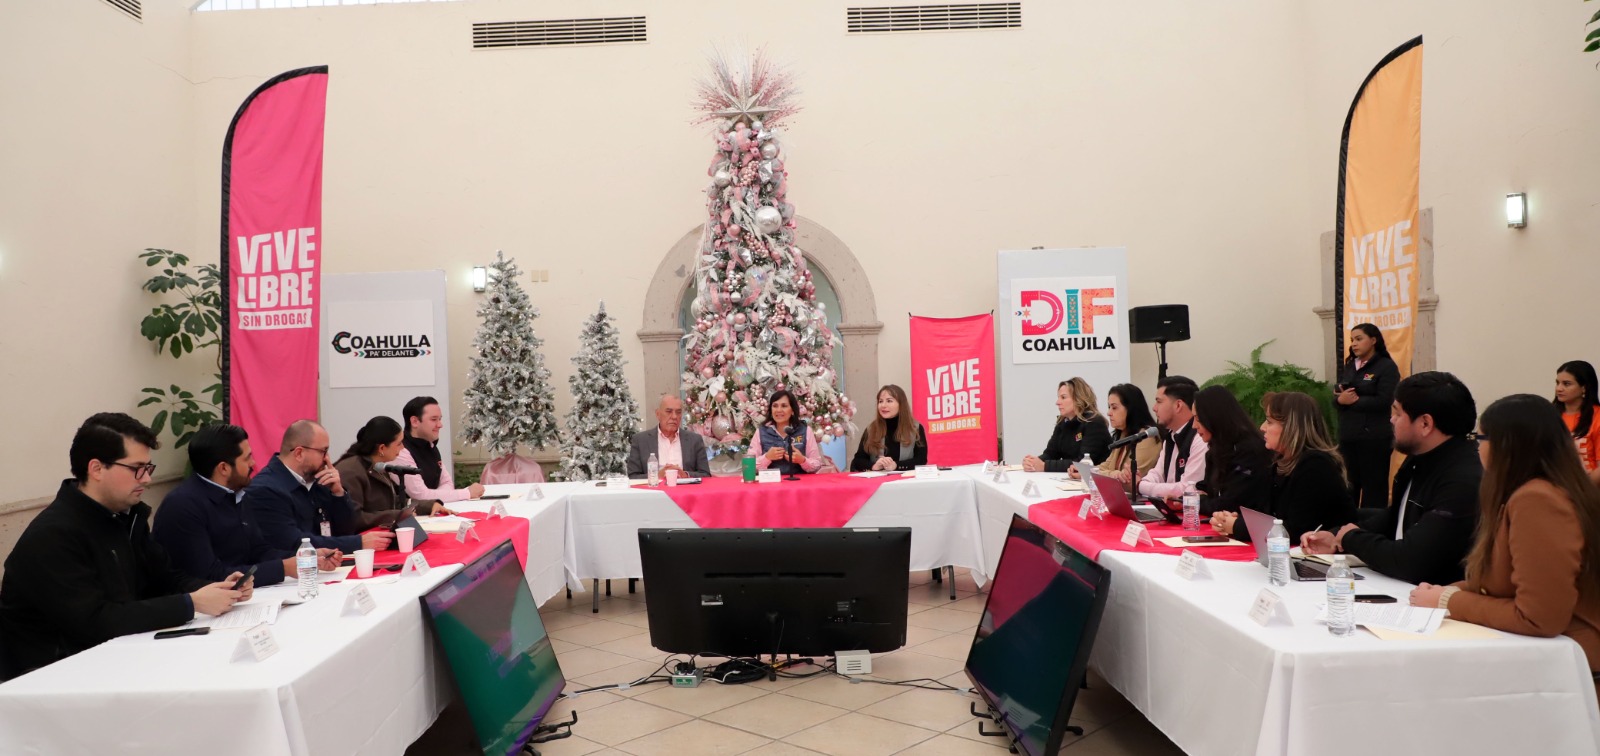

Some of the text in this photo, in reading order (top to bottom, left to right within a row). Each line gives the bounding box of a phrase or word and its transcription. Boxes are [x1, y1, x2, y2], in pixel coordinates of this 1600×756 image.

[236, 226, 315, 275] VIVE
[1352, 219, 1414, 275] VIVE
[236, 270, 313, 309] LIBRE
[242, 314, 262, 328] SIN
[1020, 287, 1115, 336] DIF
[331, 331, 431, 355] COAHUILA
[382, 349, 415, 357] DELANTE
[1022, 336, 1116, 352] COAHUILA
[926, 358, 980, 396] VIVE
[927, 388, 981, 420] LIBRE
[931, 418, 977, 433] SIN DROGAS
